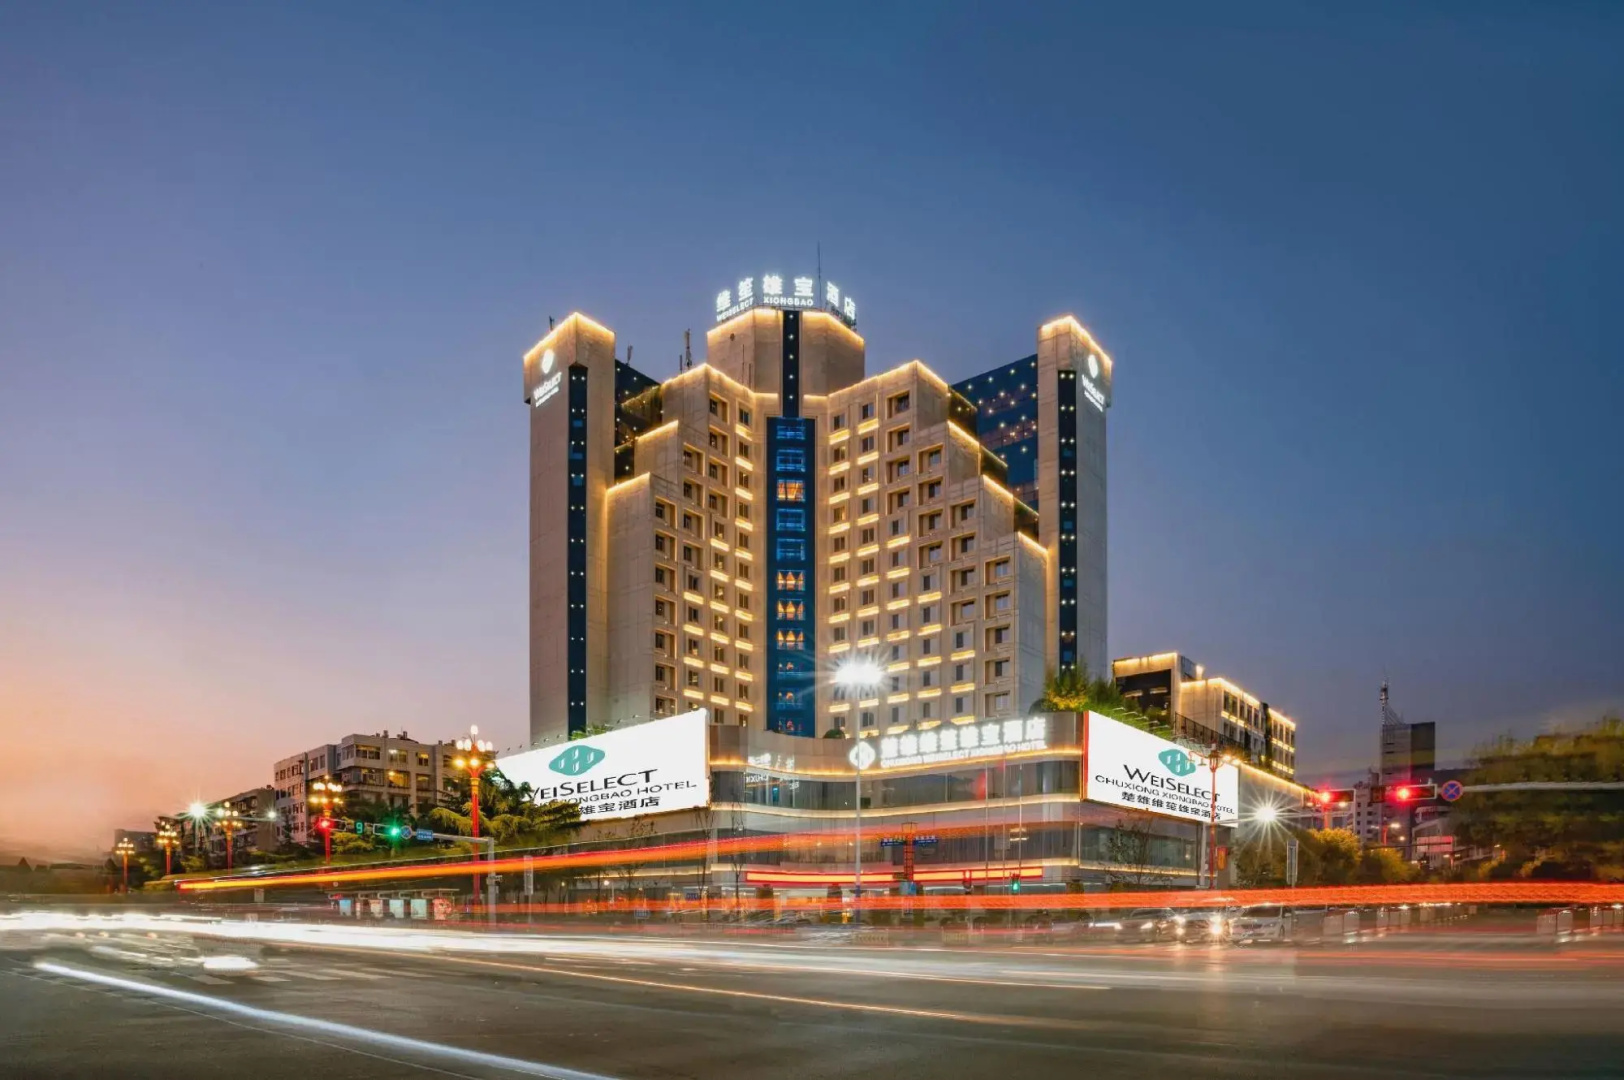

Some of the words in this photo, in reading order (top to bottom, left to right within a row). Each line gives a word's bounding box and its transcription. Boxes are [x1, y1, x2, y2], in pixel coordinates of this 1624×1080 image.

[763, 296, 814, 307] XIONGBAO
[637, 780, 697, 796] HOTEL
[1095, 774, 1160, 796] CHUXIONG
[1162, 791, 1210, 808] XIONGBAO
[1211, 803, 1235, 815] OTEL
[355, 822, 363, 834] 9
